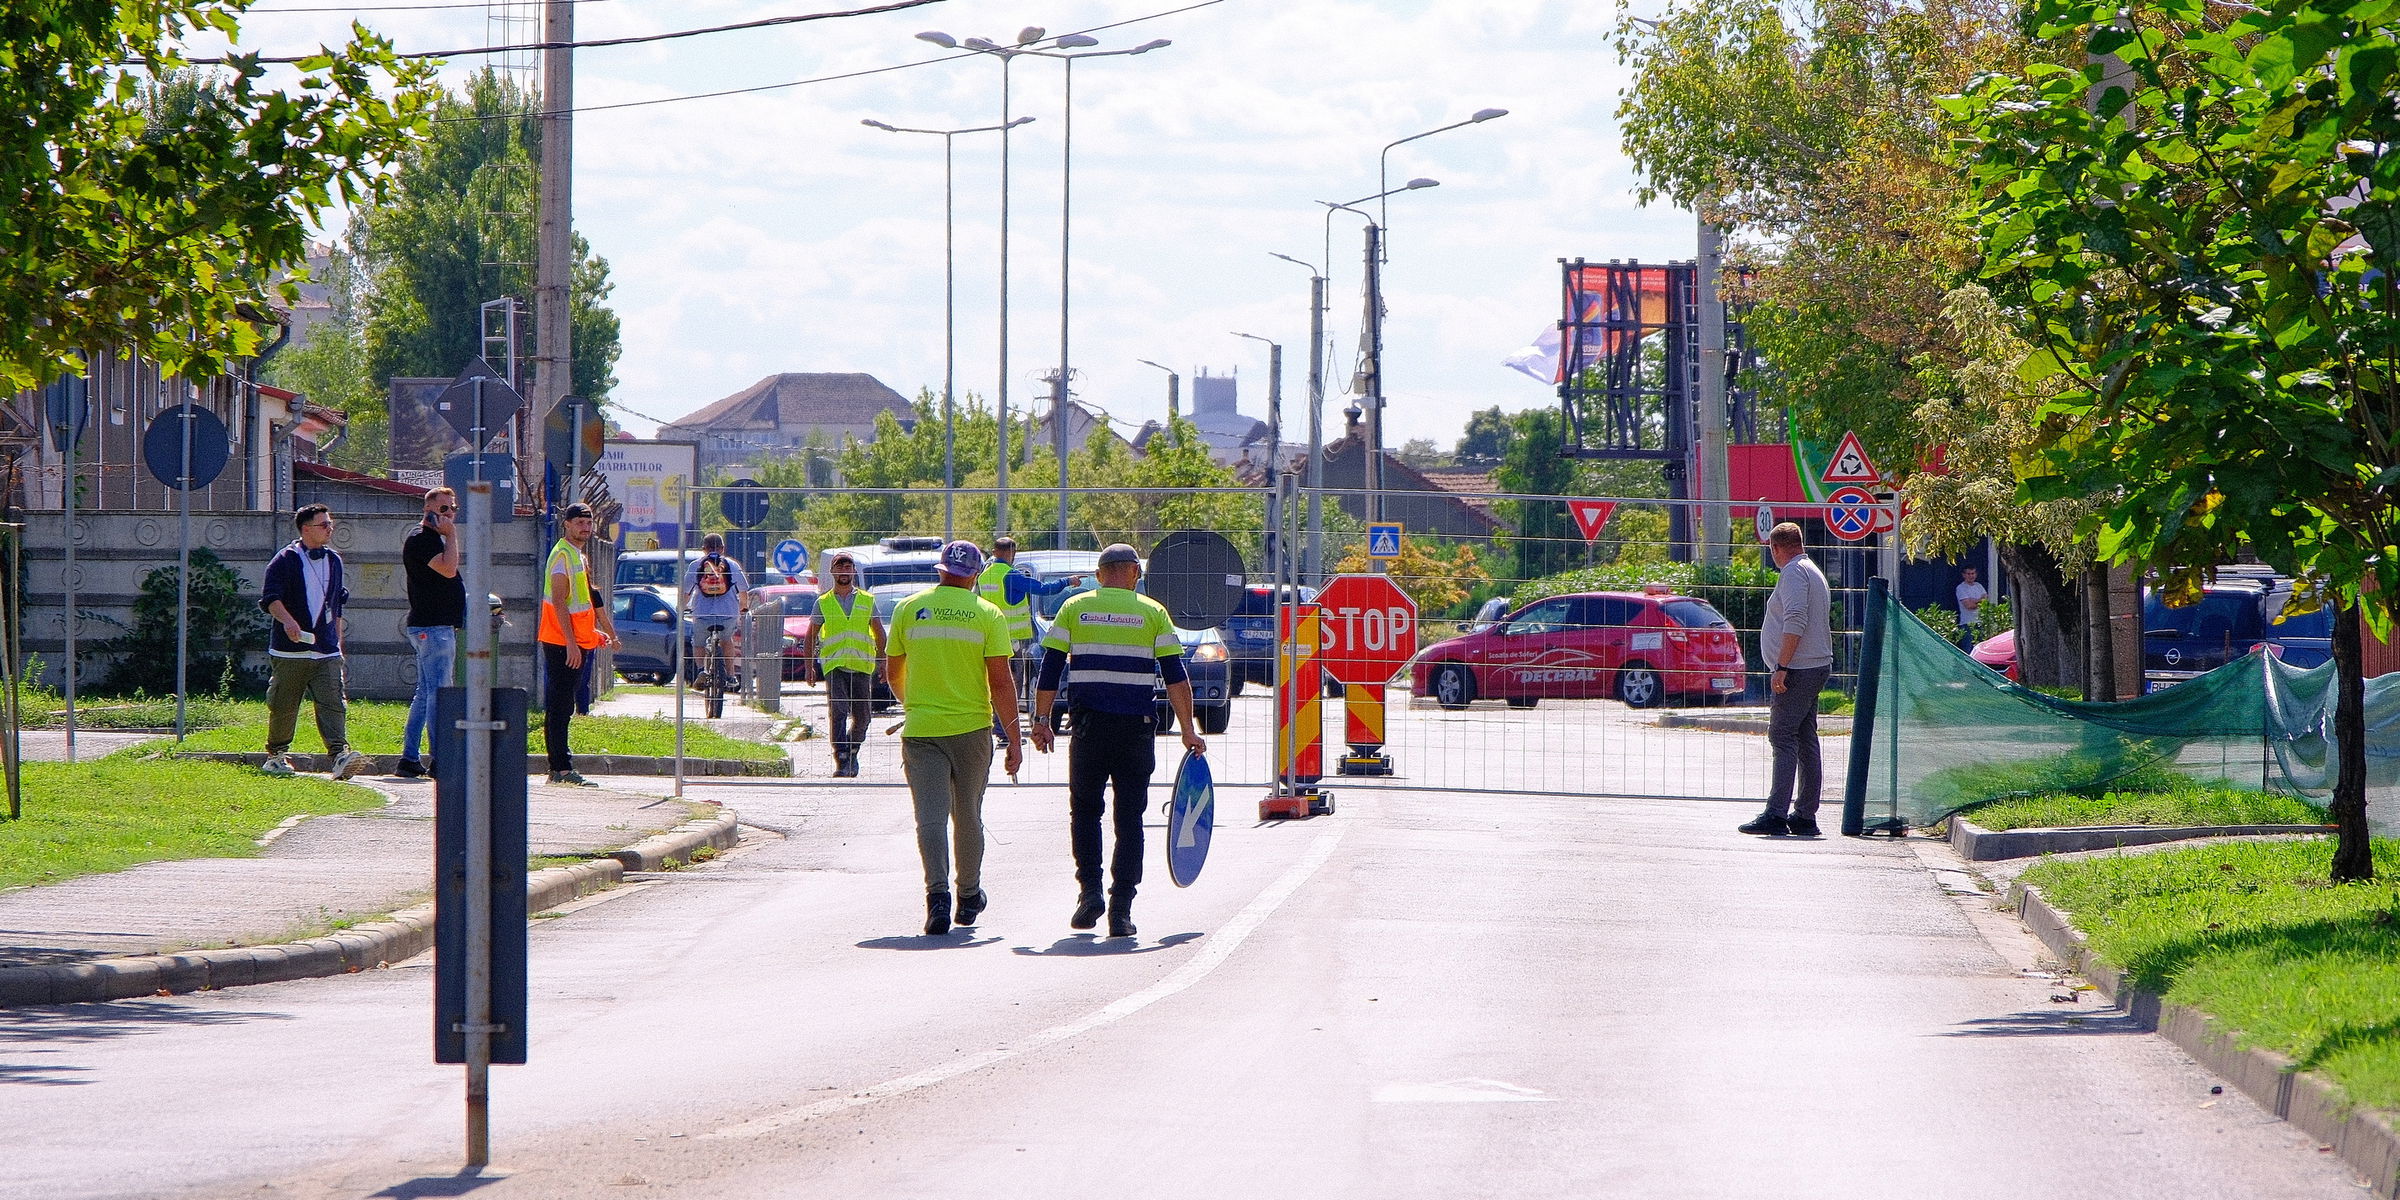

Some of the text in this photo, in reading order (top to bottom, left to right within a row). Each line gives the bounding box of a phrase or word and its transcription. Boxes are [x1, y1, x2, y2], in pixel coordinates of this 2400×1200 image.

[1760, 512, 1771, 532] 30
[950, 546, 967, 562] NY
[933, 607, 976, 619] WIZLAND
[1321, 607, 1410, 651] STOP
